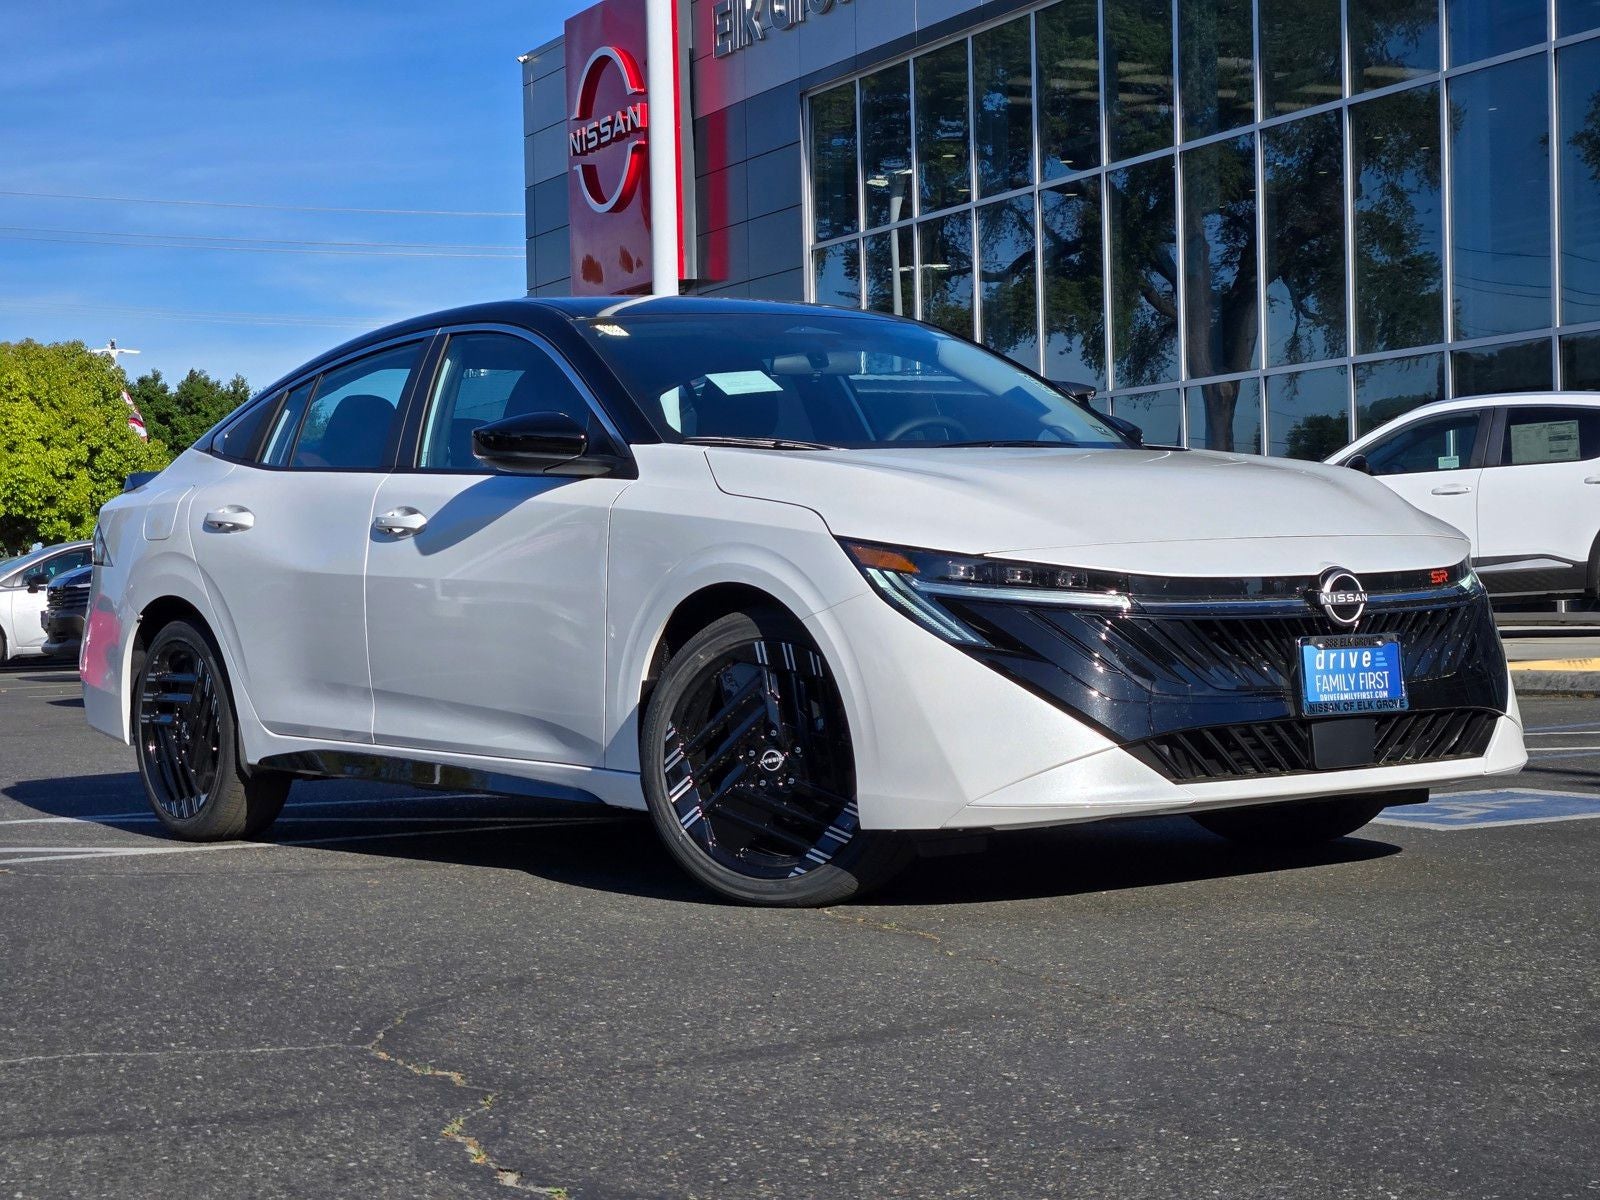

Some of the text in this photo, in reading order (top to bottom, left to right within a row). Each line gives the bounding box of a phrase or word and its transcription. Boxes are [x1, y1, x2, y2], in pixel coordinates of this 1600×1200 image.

[569, 102, 645, 157] NISSAN
[1430, 569, 1448, 584] SR
[1321, 592, 1368, 604] NISSAN
[1315, 650, 1372, 670] drive
[1315, 671, 1389, 693] FAMILY FIRST
[1319, 690, 1389, 702] DRIVEFAMILYFIRST.COM
[1309, 699, 1405, 713] NISSAN OF ELK GROVE
